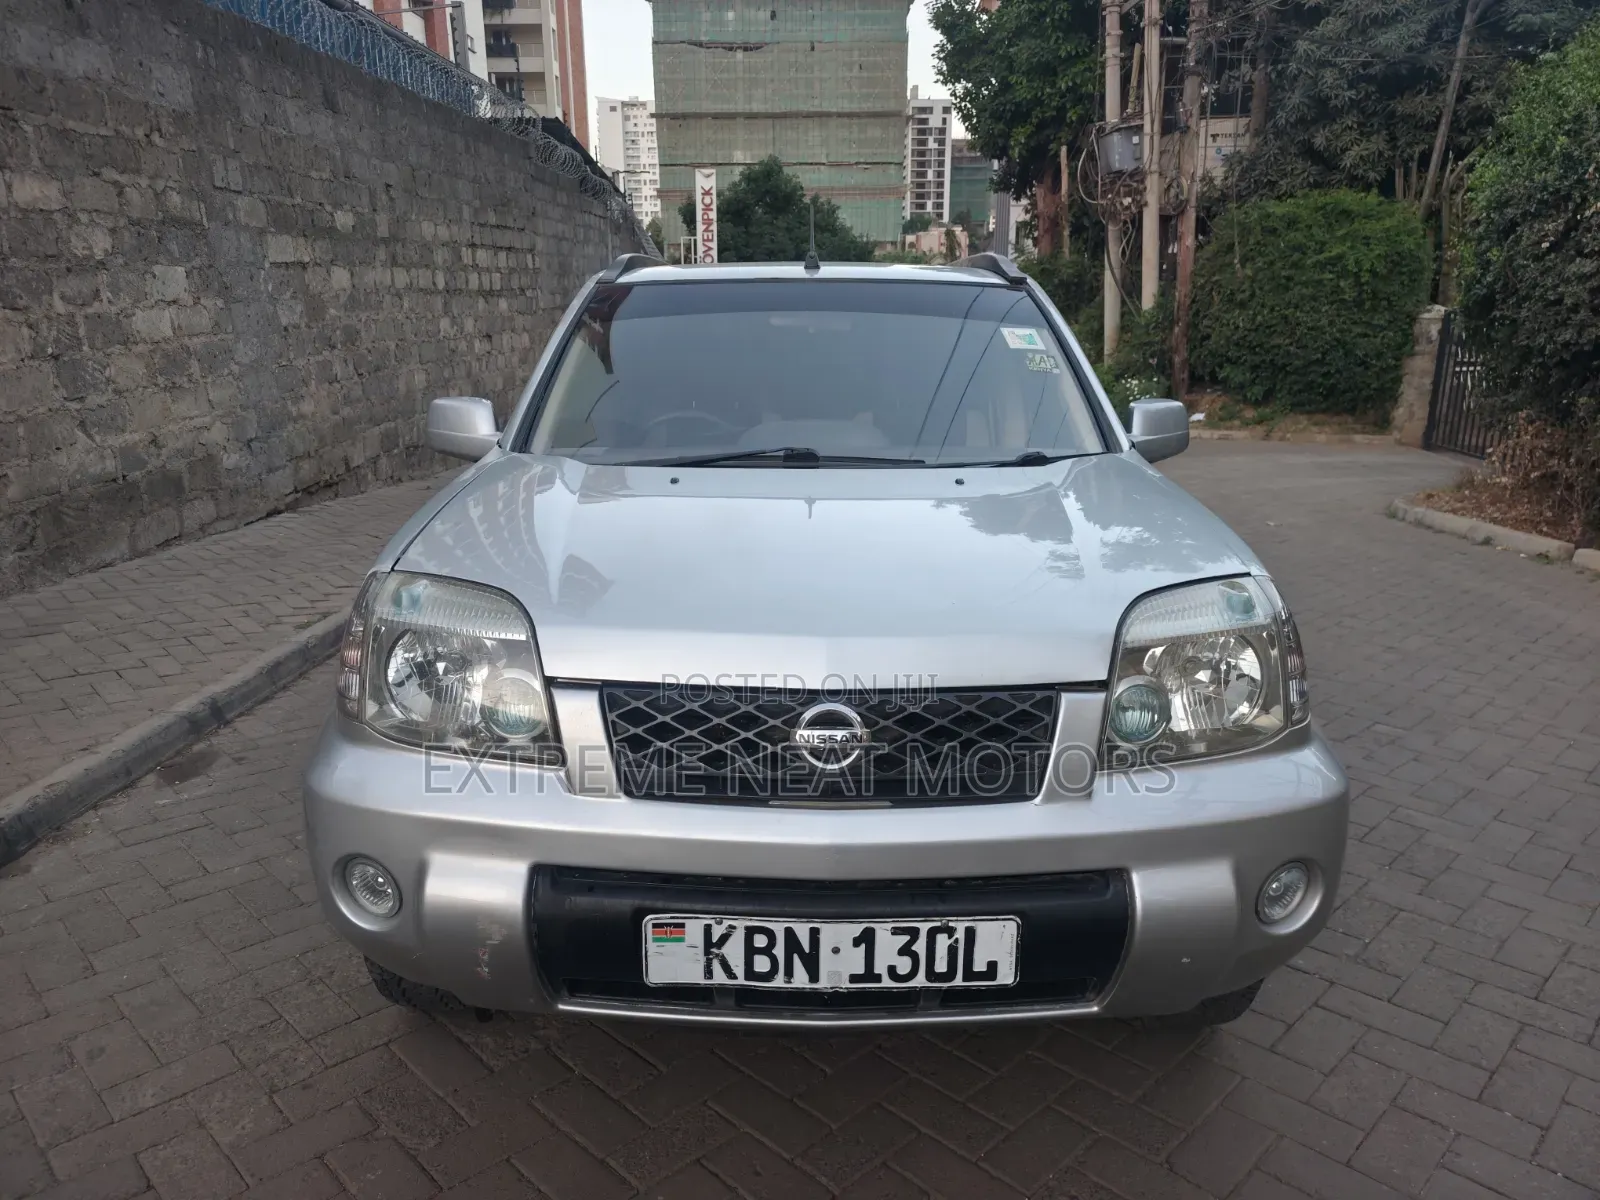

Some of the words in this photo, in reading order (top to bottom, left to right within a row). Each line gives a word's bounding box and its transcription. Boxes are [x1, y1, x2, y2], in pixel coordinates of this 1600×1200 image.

[798, 734, 863, 744] NISSAN
[703, 923, 820, 985] KBN
[848, 925, 998, 985] 130L
